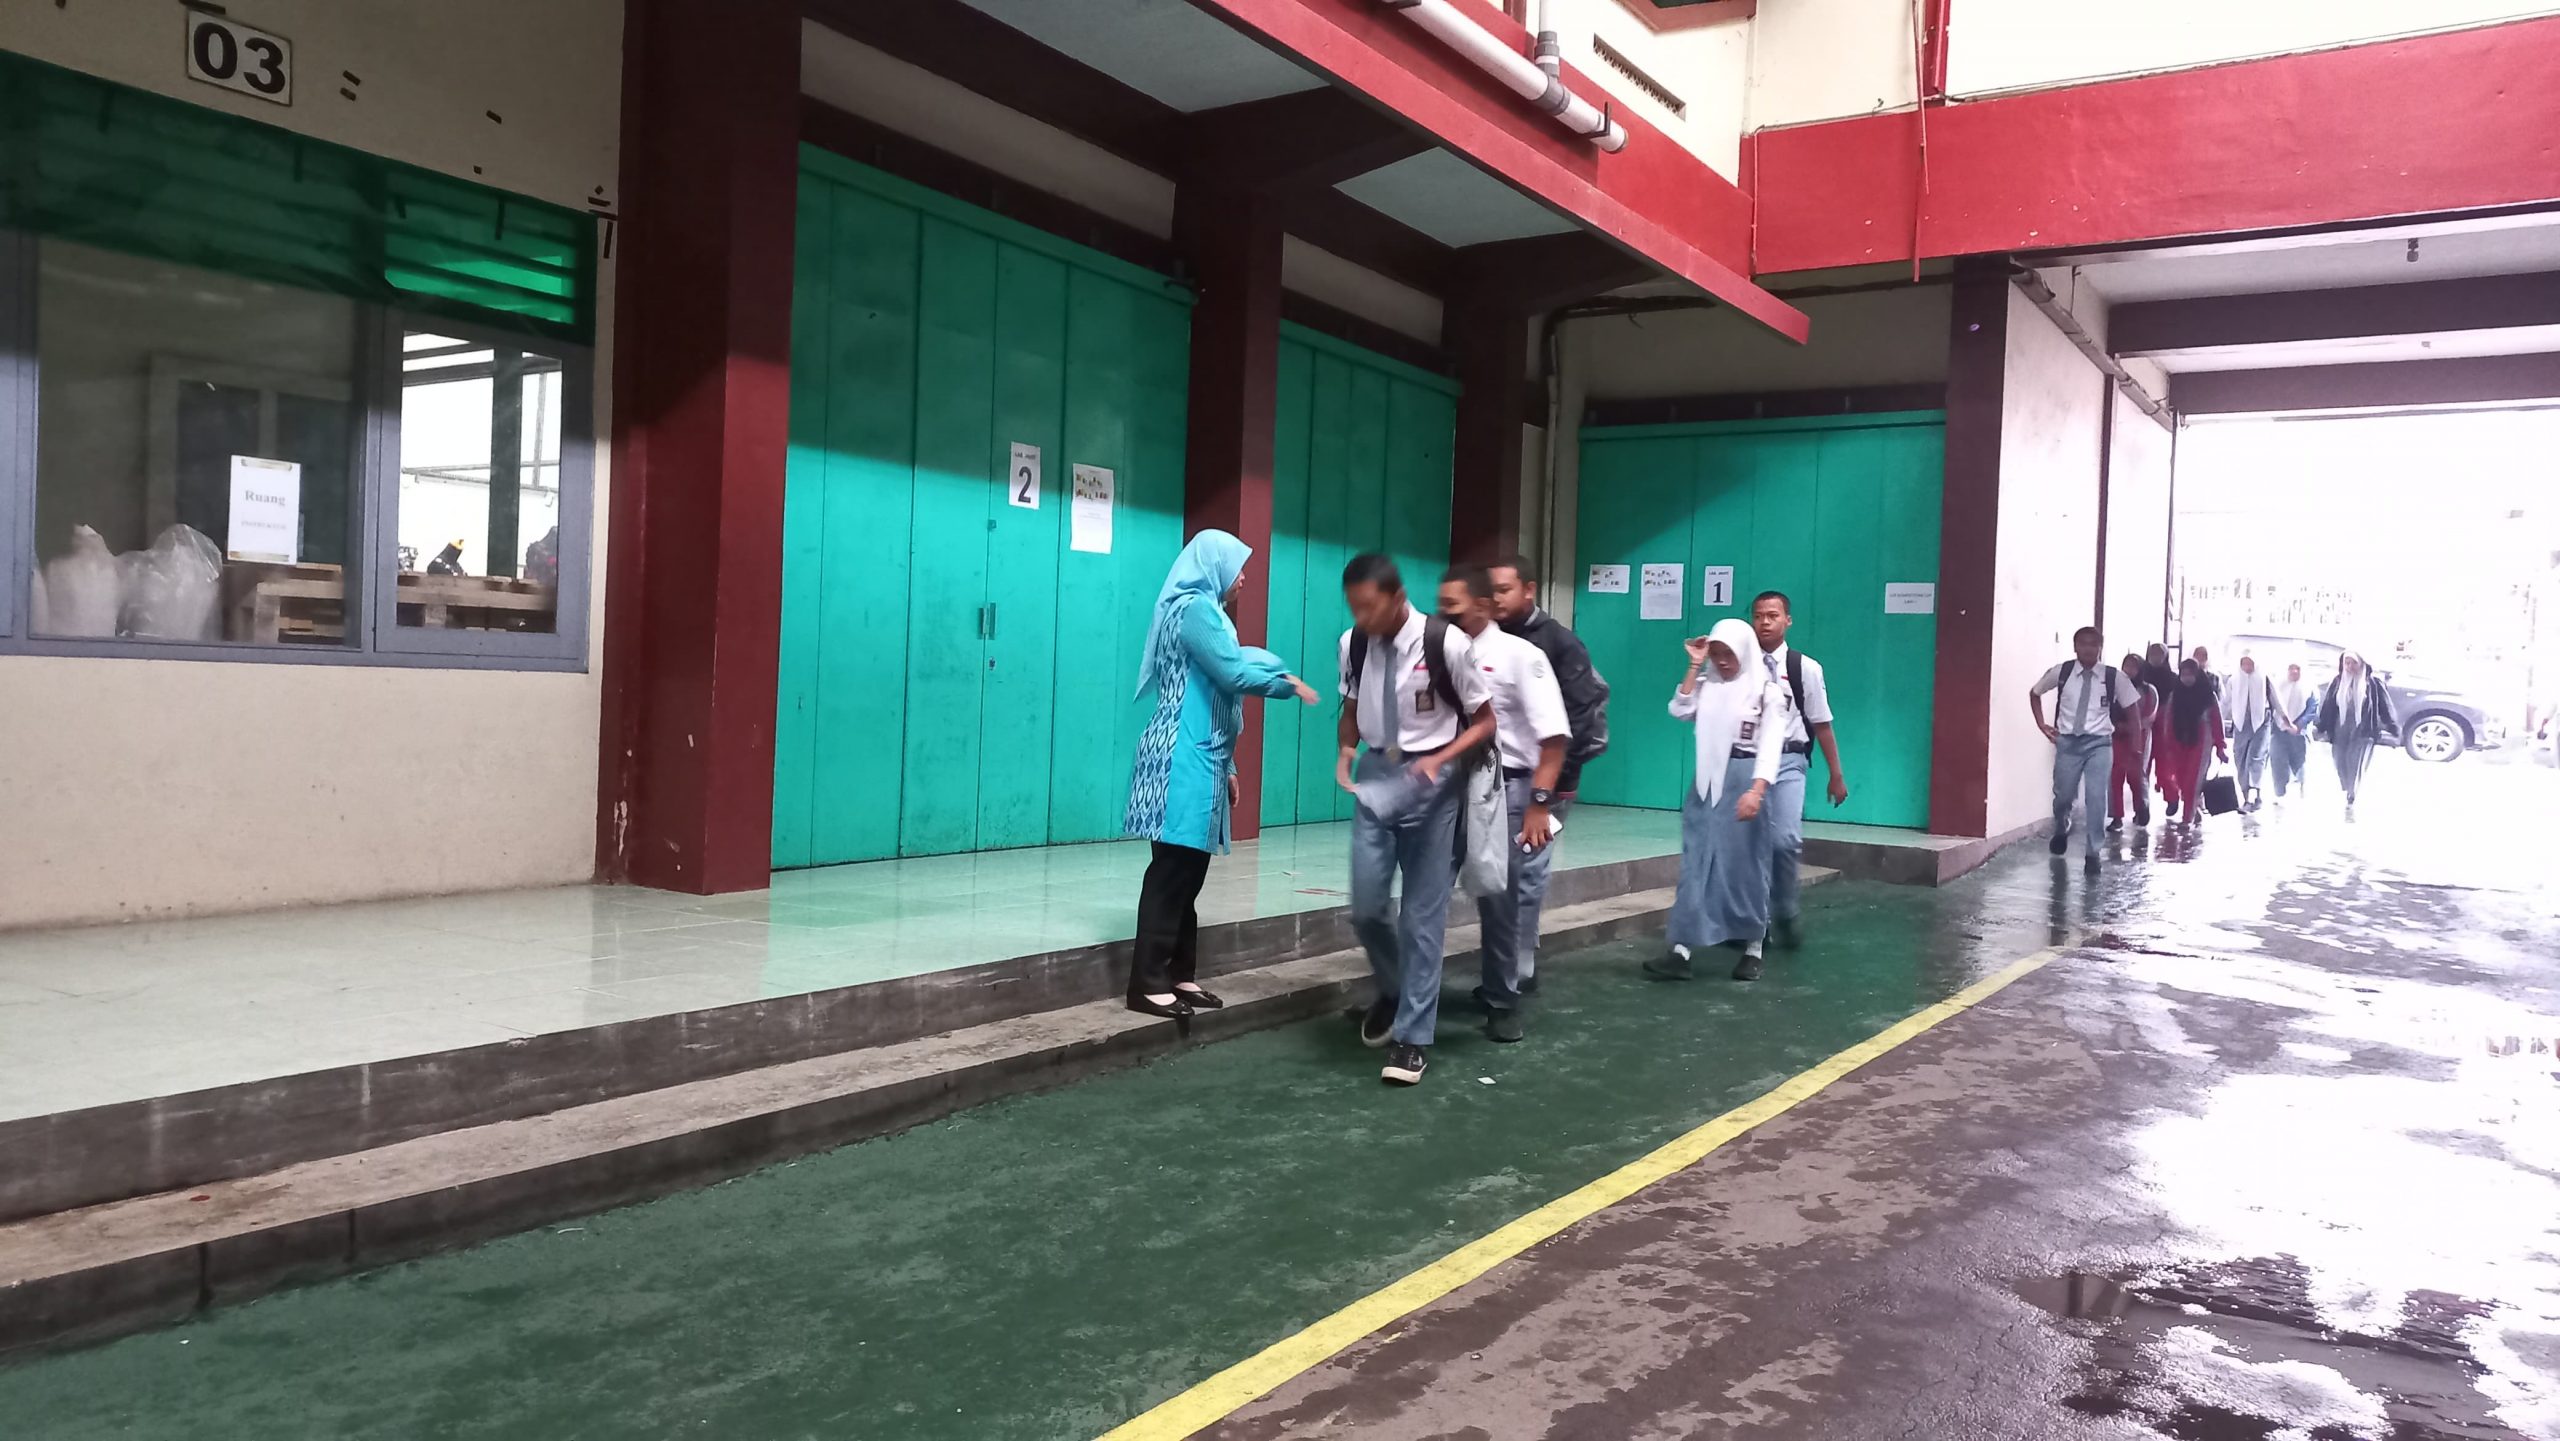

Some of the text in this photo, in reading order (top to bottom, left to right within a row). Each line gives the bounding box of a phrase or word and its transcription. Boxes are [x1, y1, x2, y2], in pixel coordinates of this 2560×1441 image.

[193, 22, 286, 94] 03
[245, 489, 286, 506] Ruang
[1017, 466, 1032, 503] 2
[1712, 581, 1724, 603] 1
